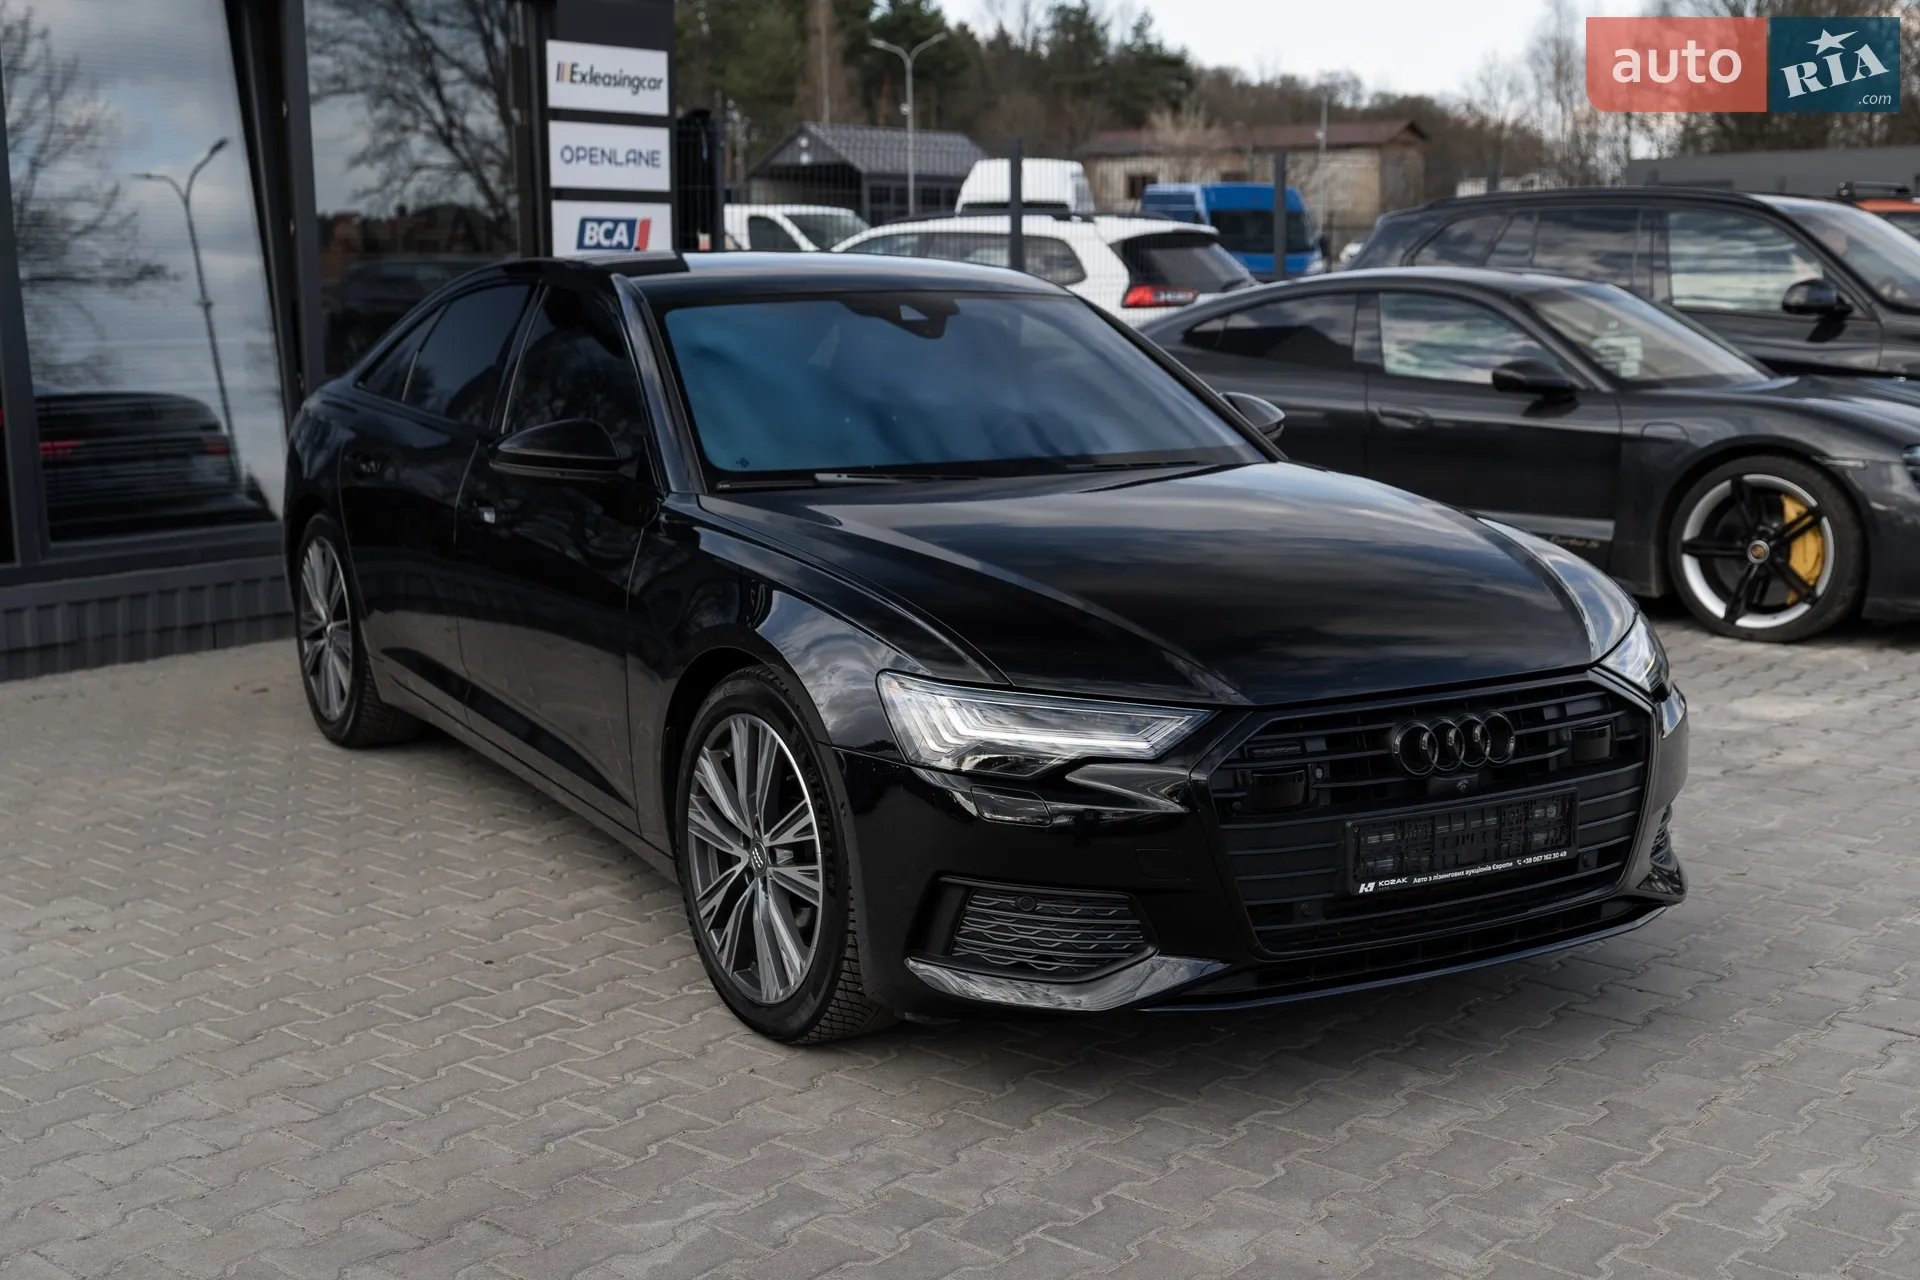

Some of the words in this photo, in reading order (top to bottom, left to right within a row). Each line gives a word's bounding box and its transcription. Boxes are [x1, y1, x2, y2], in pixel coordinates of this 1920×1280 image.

[570, 62, 664, 96] Exleasingcar
[561, 145, 661, 168] OPENLANE
[583, 221, 630, 248] BCA
[1543, 853, 1552, 861] 162
[1433, 870, 1464, 880] лізингових
[1492, 861, 1513, 871] Європи
[1378, 877, 1408, 887] KOZAK
